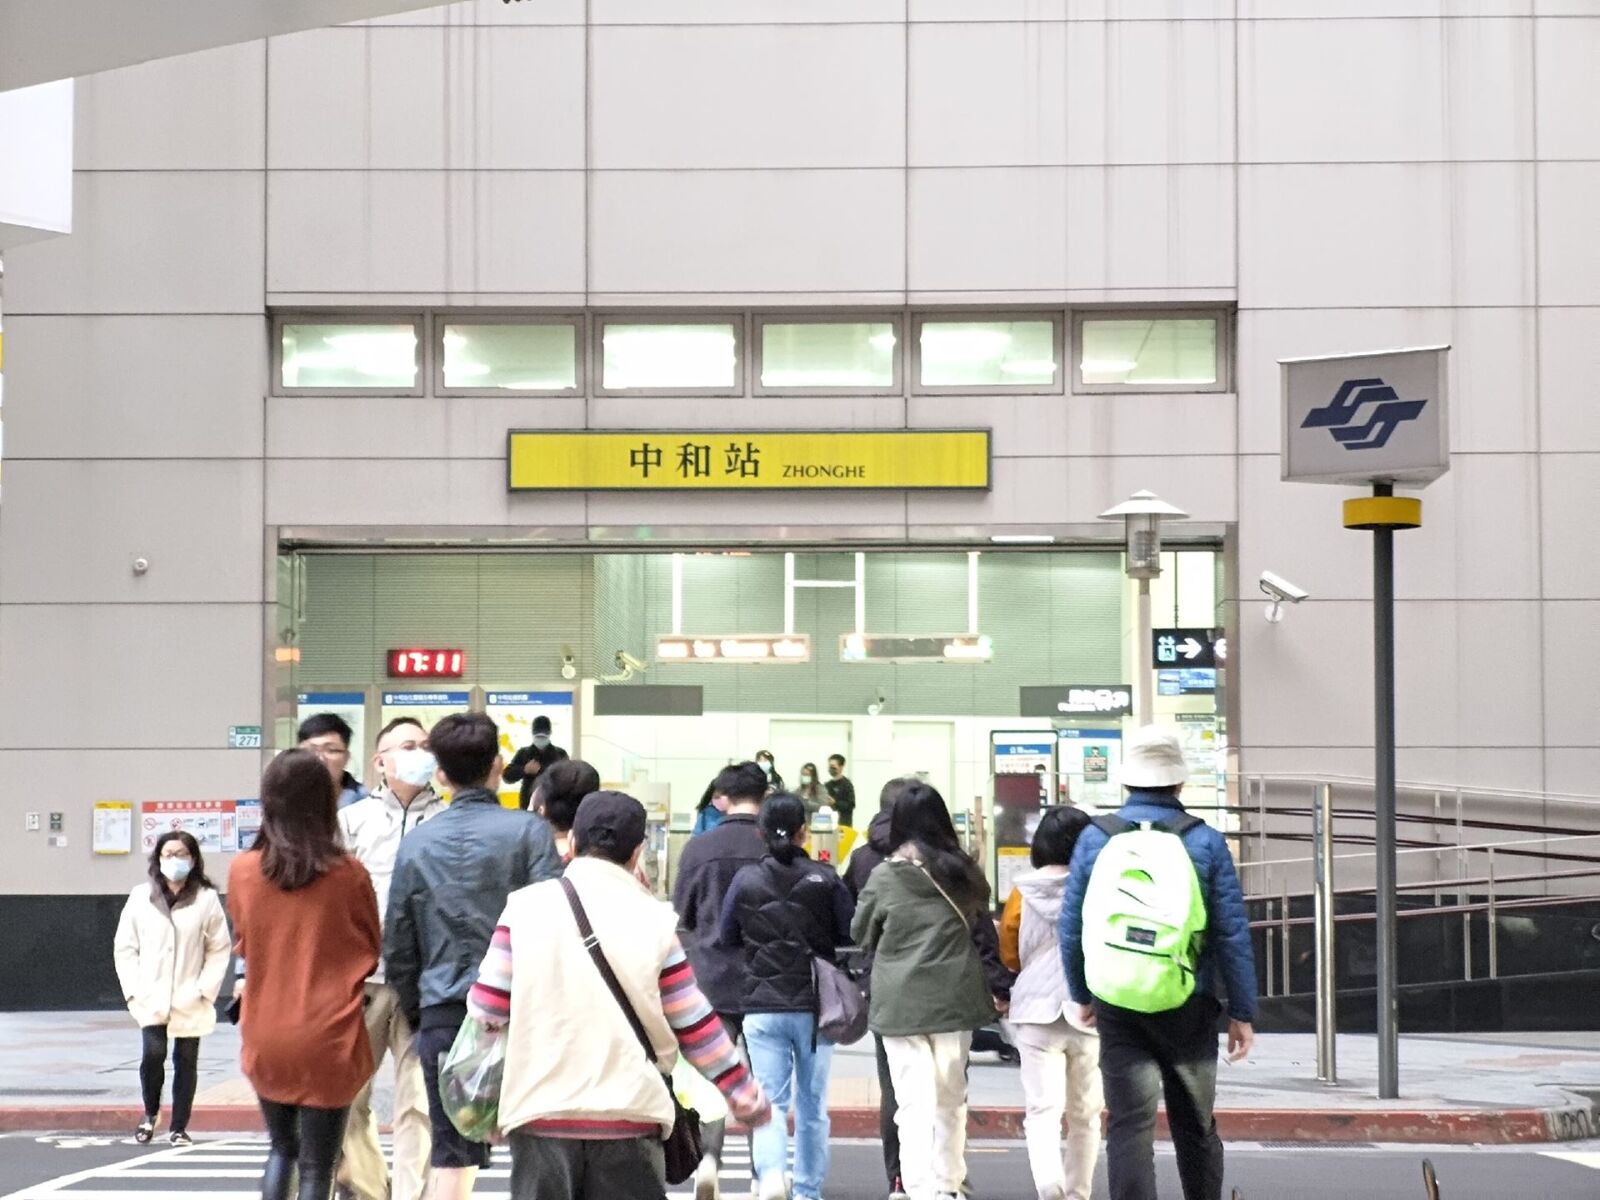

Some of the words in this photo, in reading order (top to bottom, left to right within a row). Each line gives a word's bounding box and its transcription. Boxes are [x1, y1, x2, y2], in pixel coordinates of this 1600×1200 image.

[629, 442, 761, 479] 中和站
[782, 464, 866, 479] ZHONGHE
[397, 652, 461, 673] 17:11
[239, 735, 259, 746] 271
